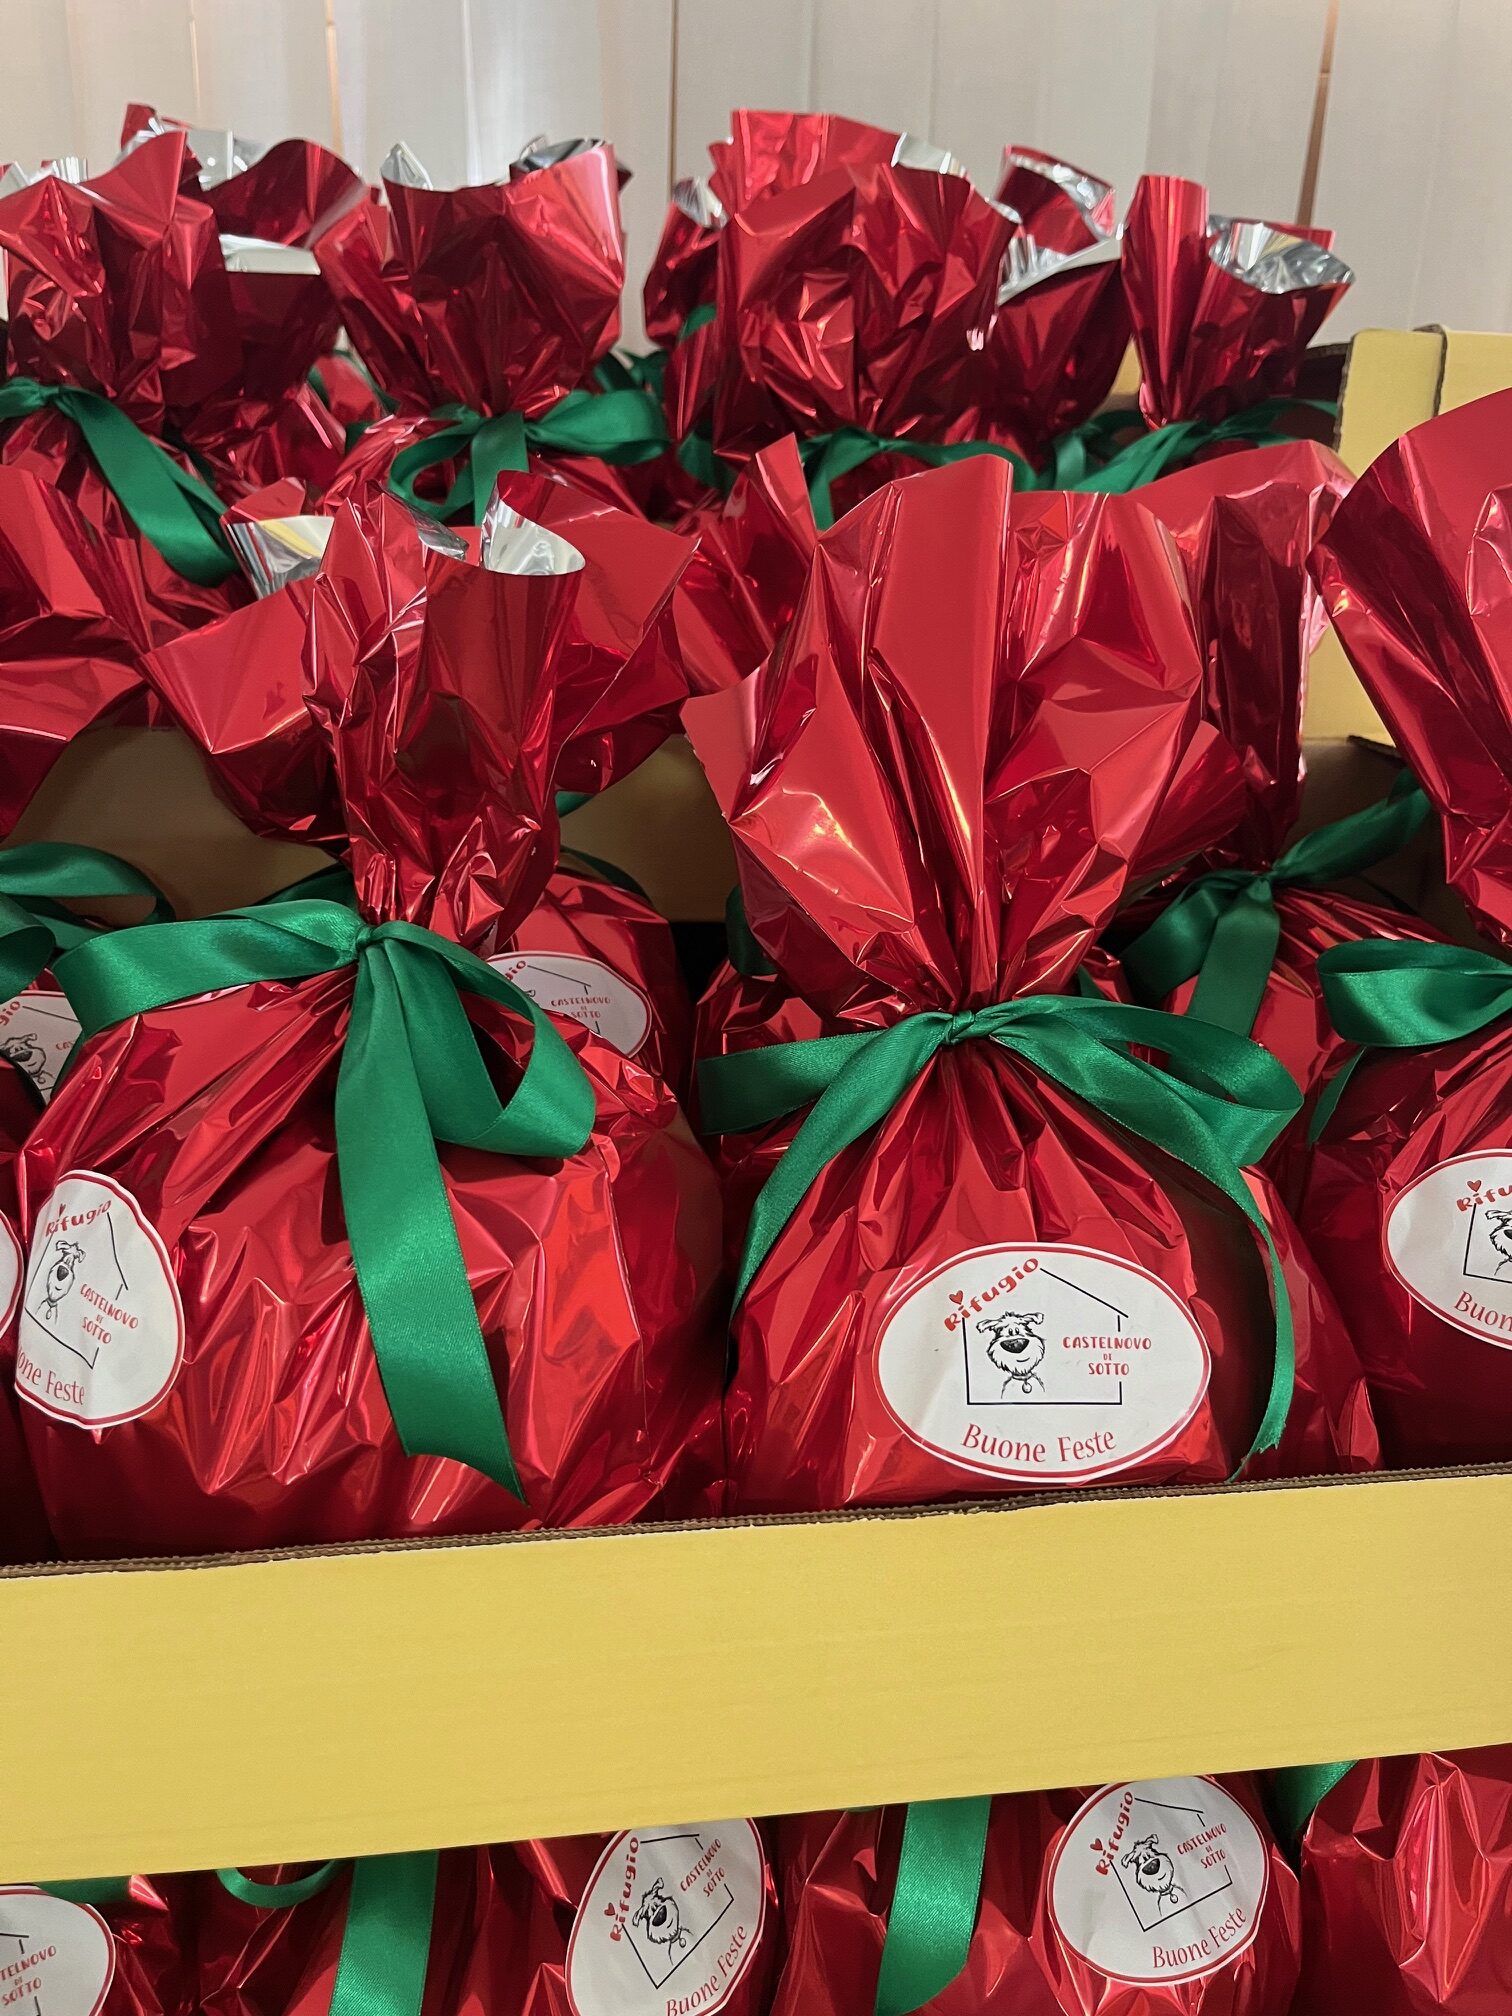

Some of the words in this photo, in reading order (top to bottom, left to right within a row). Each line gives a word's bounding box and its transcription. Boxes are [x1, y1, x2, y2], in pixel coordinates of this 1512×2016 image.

[571, 1010, 601, 1018] SOTTO
[1456, 1185, 1512, 1212] Rifu
[80, 1283, 139, 1329] CASTELNOVO
[1454, 1290, 1512, 1332] Buon
[82, 1316, 112, 1344] SOTTO
[1062, 1336, 1152, 1350] CASTELNOVO
[1088, 1362, 1130, 1376] SOTTO
[1103, 1353, 1112, 1361] DI
[17, 1347, 42, 1386] one
[45, 1370, 85, 1406] Feste
[960, 1423, 1046, 1463] Buone
[1057, 1430, 1117, 1463] Feste
[1177, 1823, 1227, 1855] CASTELNOVO
[680, 1838, 722, 1892] CASTELNOVO
[1200, 1849, 1226, 1869] SOTTO
[703, 1867, 725, 1897] SOTTO
[1152, 1939, 1209, 1969] Buone
[1208, 1907, 1247, 1948] Feste
[0, 1945, 57, 1981] TELNOVO
[666, 1975, 721, 2016] Buone
[717, 1925, 748, 1978] Feste
[2, 1977, 42, 2006] SOTTO
